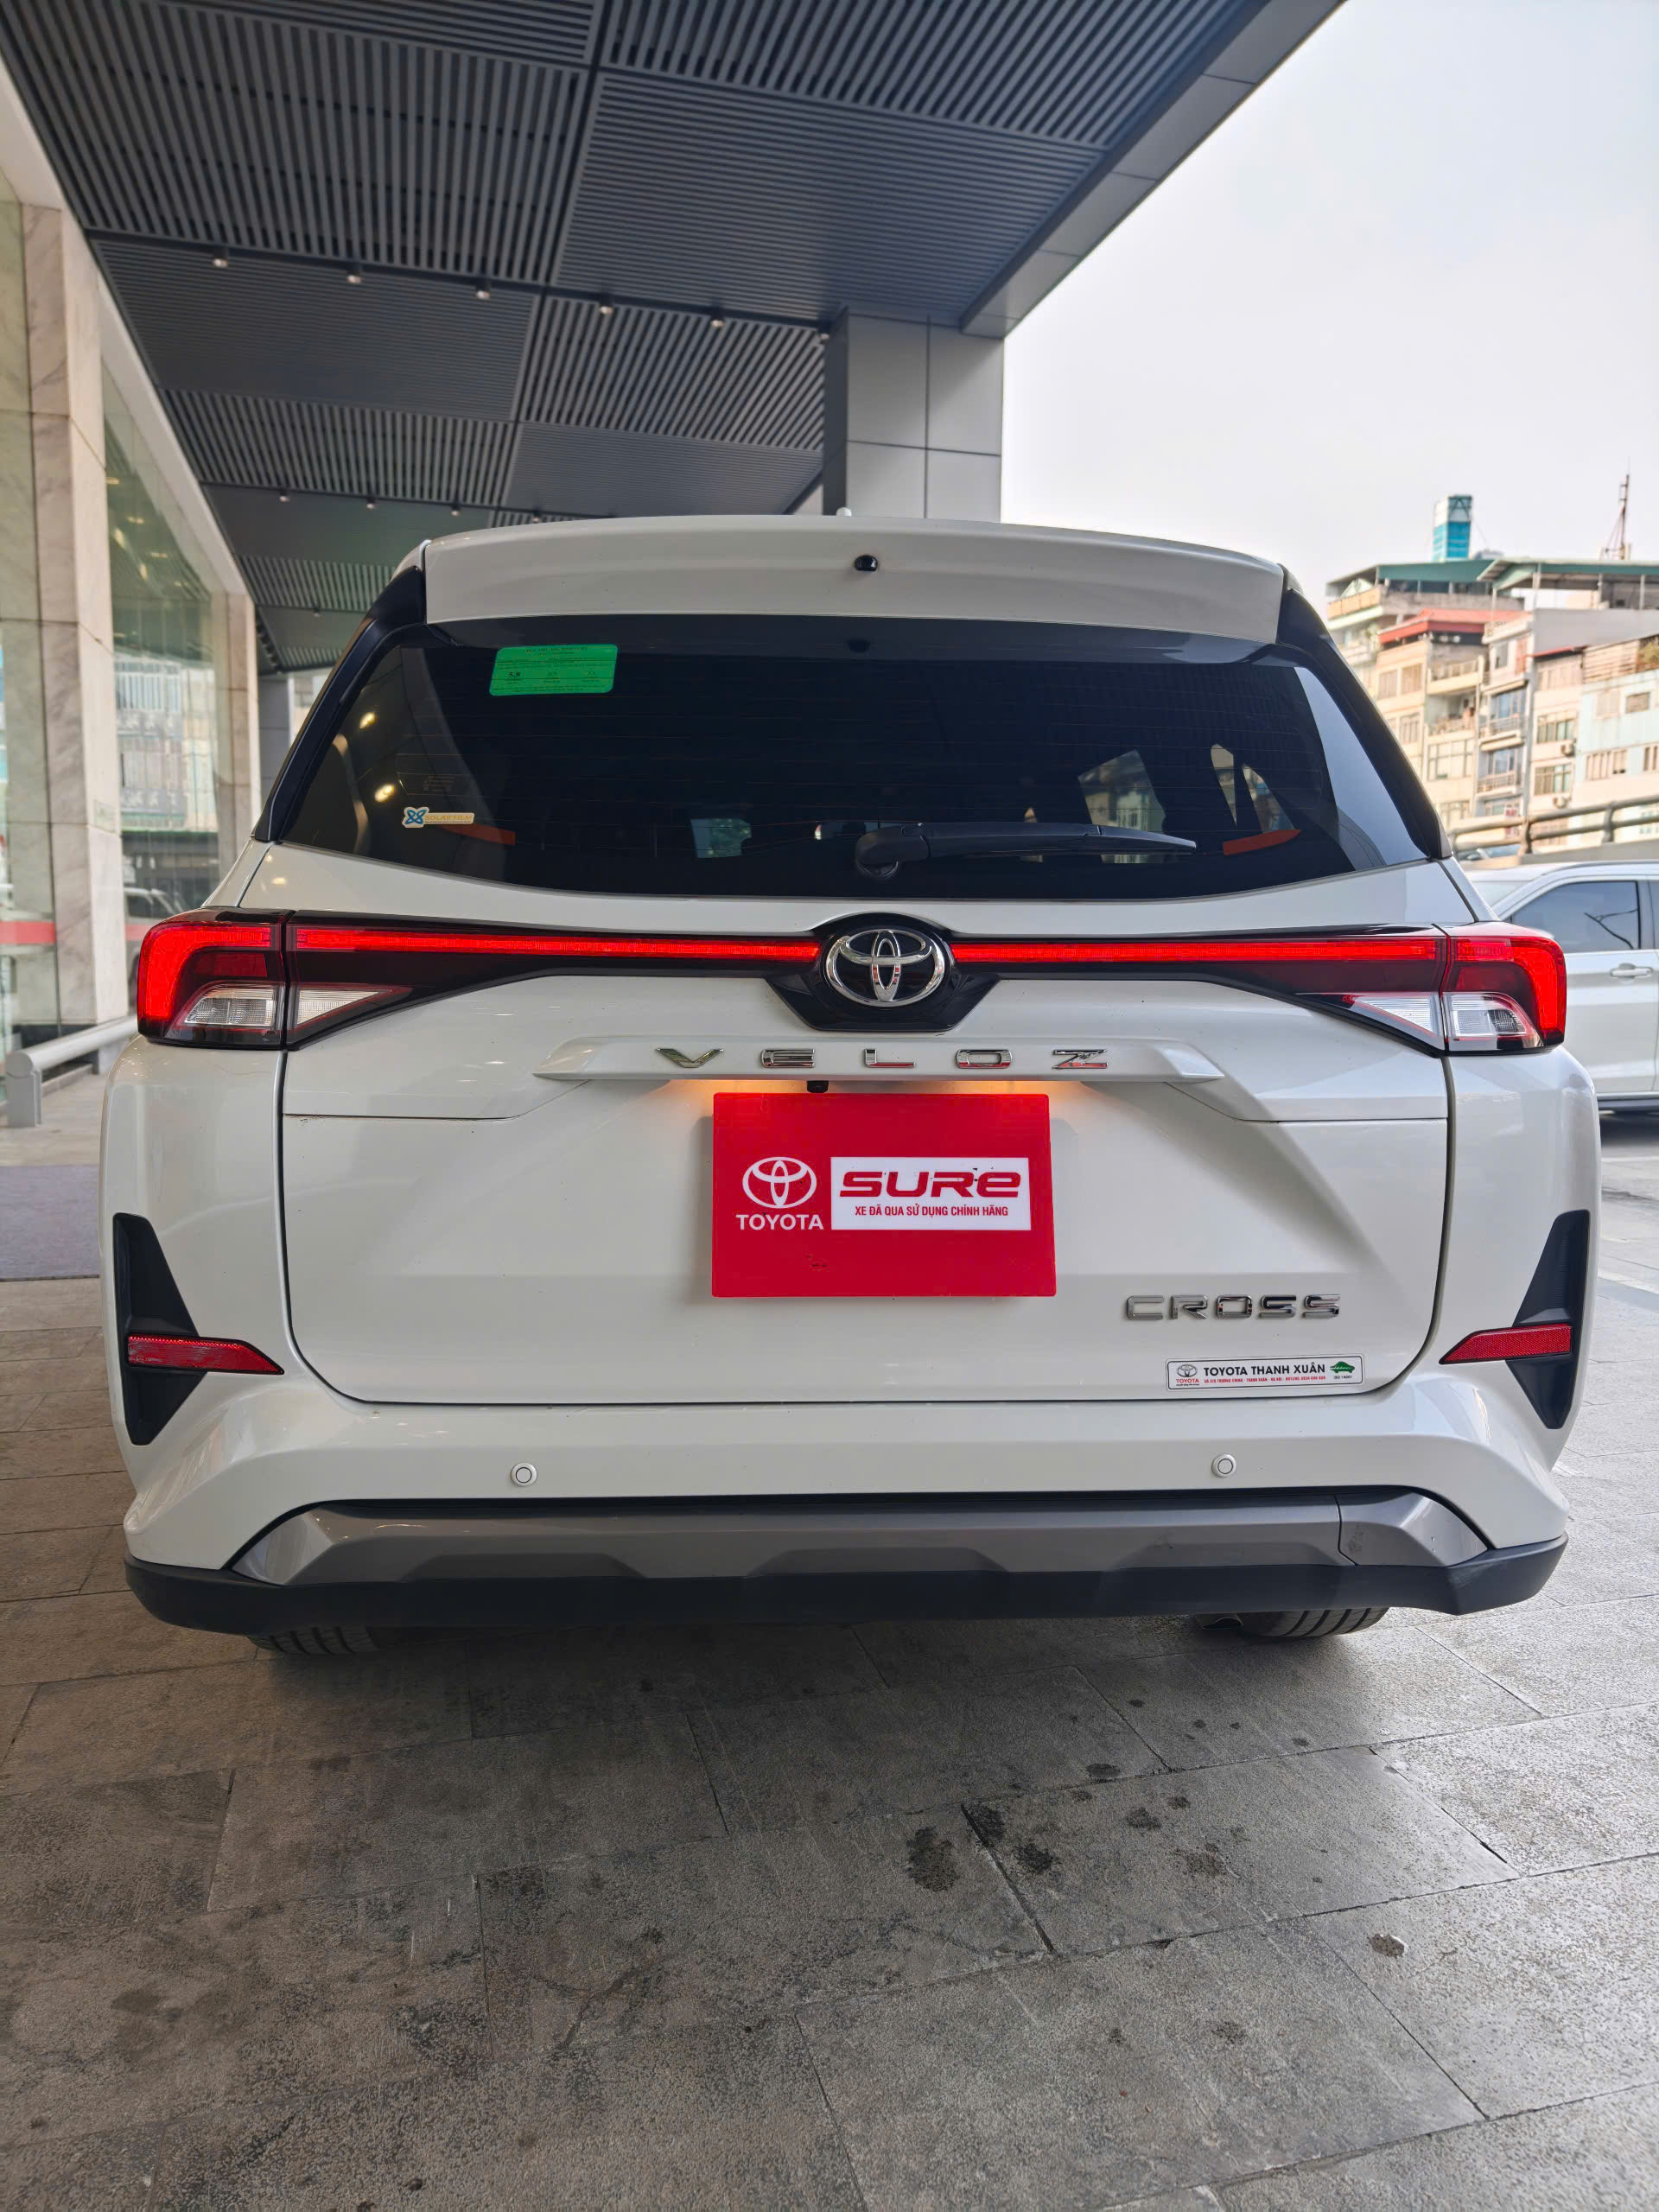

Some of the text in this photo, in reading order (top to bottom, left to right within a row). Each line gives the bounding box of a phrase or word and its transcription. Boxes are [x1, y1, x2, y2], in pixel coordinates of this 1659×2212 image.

[655, 1047, 1108, 1070] VELOZ
[855, 1203, 1009, 1218] XE ĐÃ QUA SỬ DỤNG CHÍNH HÃNG
[736, 1213, 824, 1231] TOYOTA
[1126, 1294, 1341, 1320] CROSS
[1204, 1362, 1325, 1376] TOYOTA THANH XUÂN
